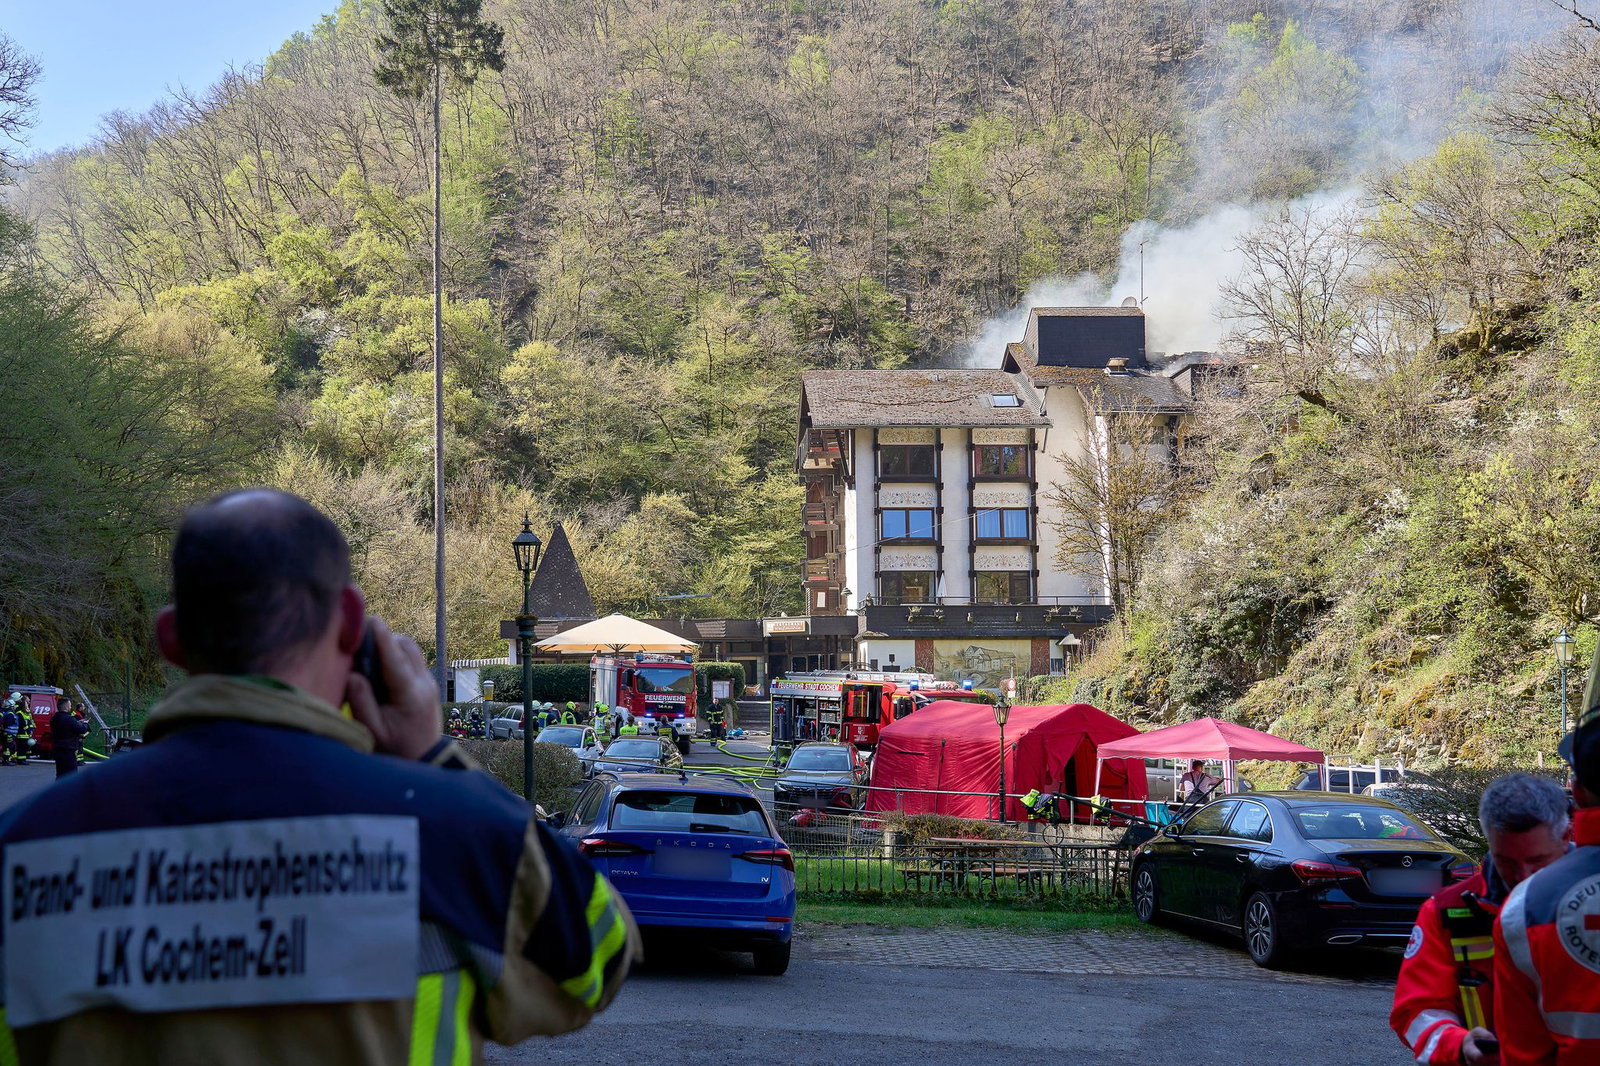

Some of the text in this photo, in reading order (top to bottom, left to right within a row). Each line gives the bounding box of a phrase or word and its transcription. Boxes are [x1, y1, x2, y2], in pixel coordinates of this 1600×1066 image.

[778, 682, 804, 690] FEUERWEHR
[33, 705, 51, 715] 112
[11, 835, 408, 921] Brand- und Katastrophenschutz
[96, 917, 308, 987] LK Cochem-Zell
[1565, 925, 1600, 966] ROTE
